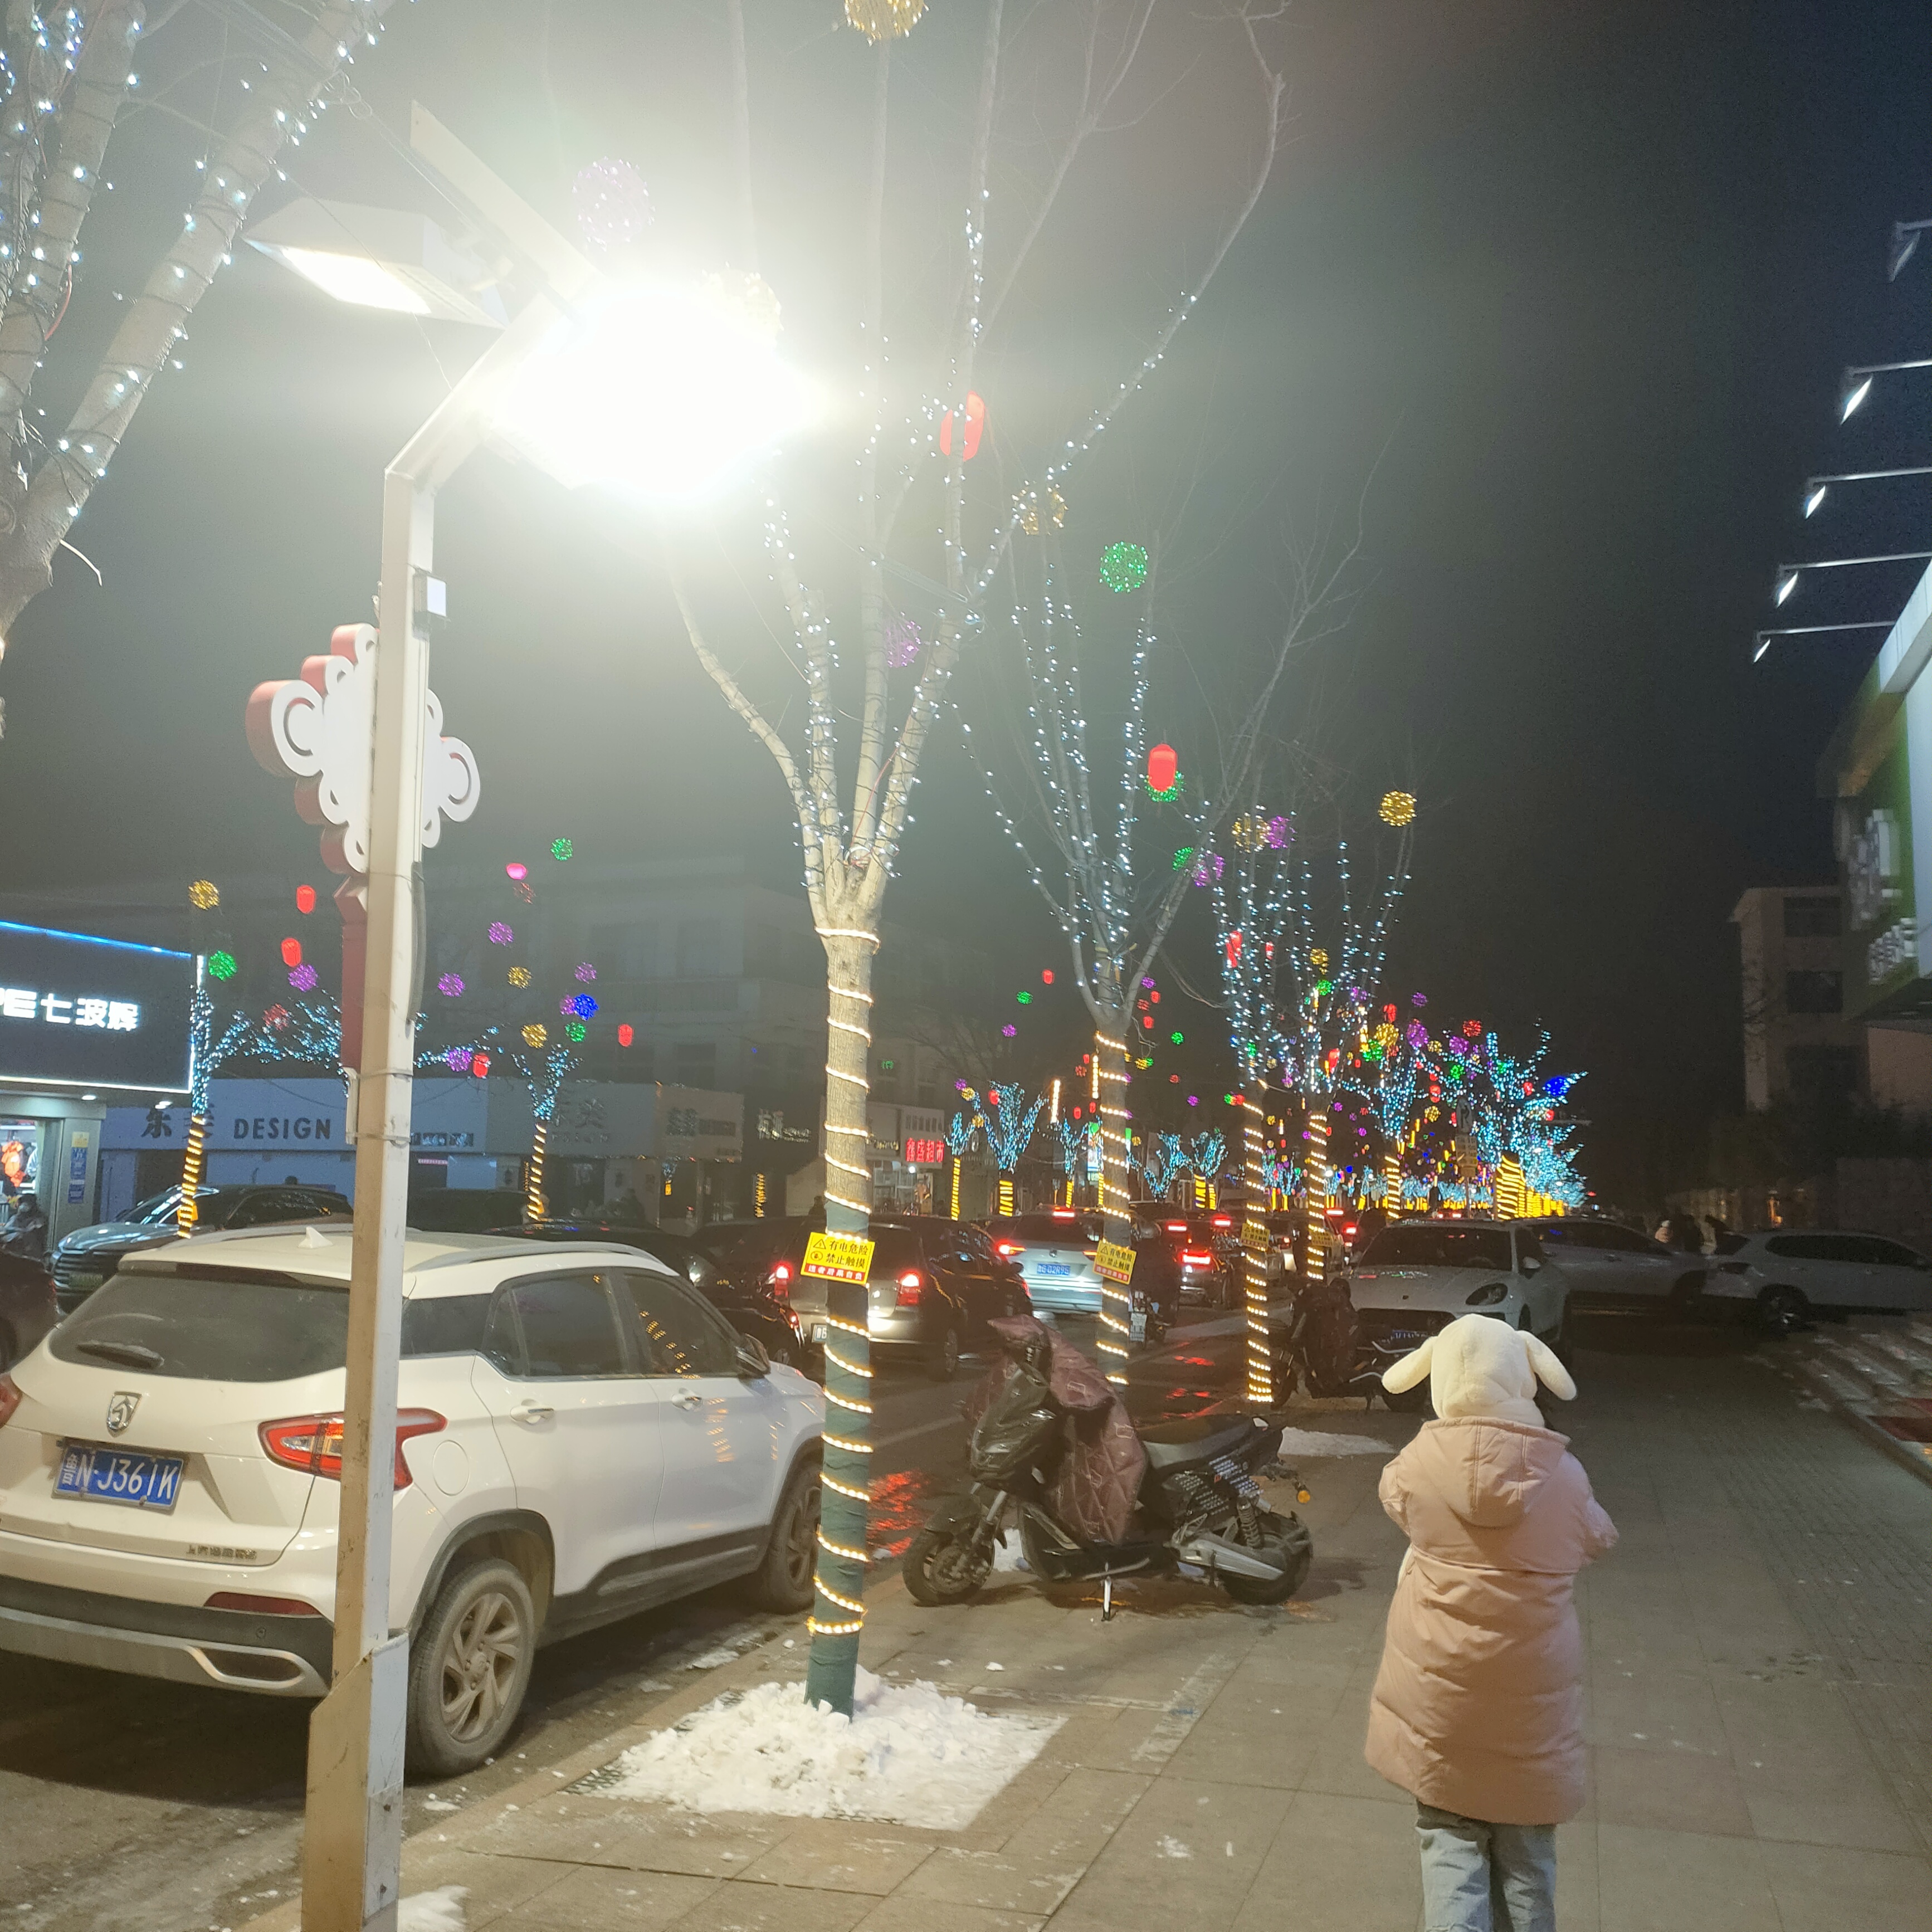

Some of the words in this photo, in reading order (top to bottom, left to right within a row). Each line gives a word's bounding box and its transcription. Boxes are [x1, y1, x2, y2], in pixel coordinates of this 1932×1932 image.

[41, 993, 138, 1031] 七波辉
[233, 1117, 331, 1140] DESIGN
[830, 1241, 868, 1256] 有电危险
[826, 1253, 865, 1269] 禁止触摸
